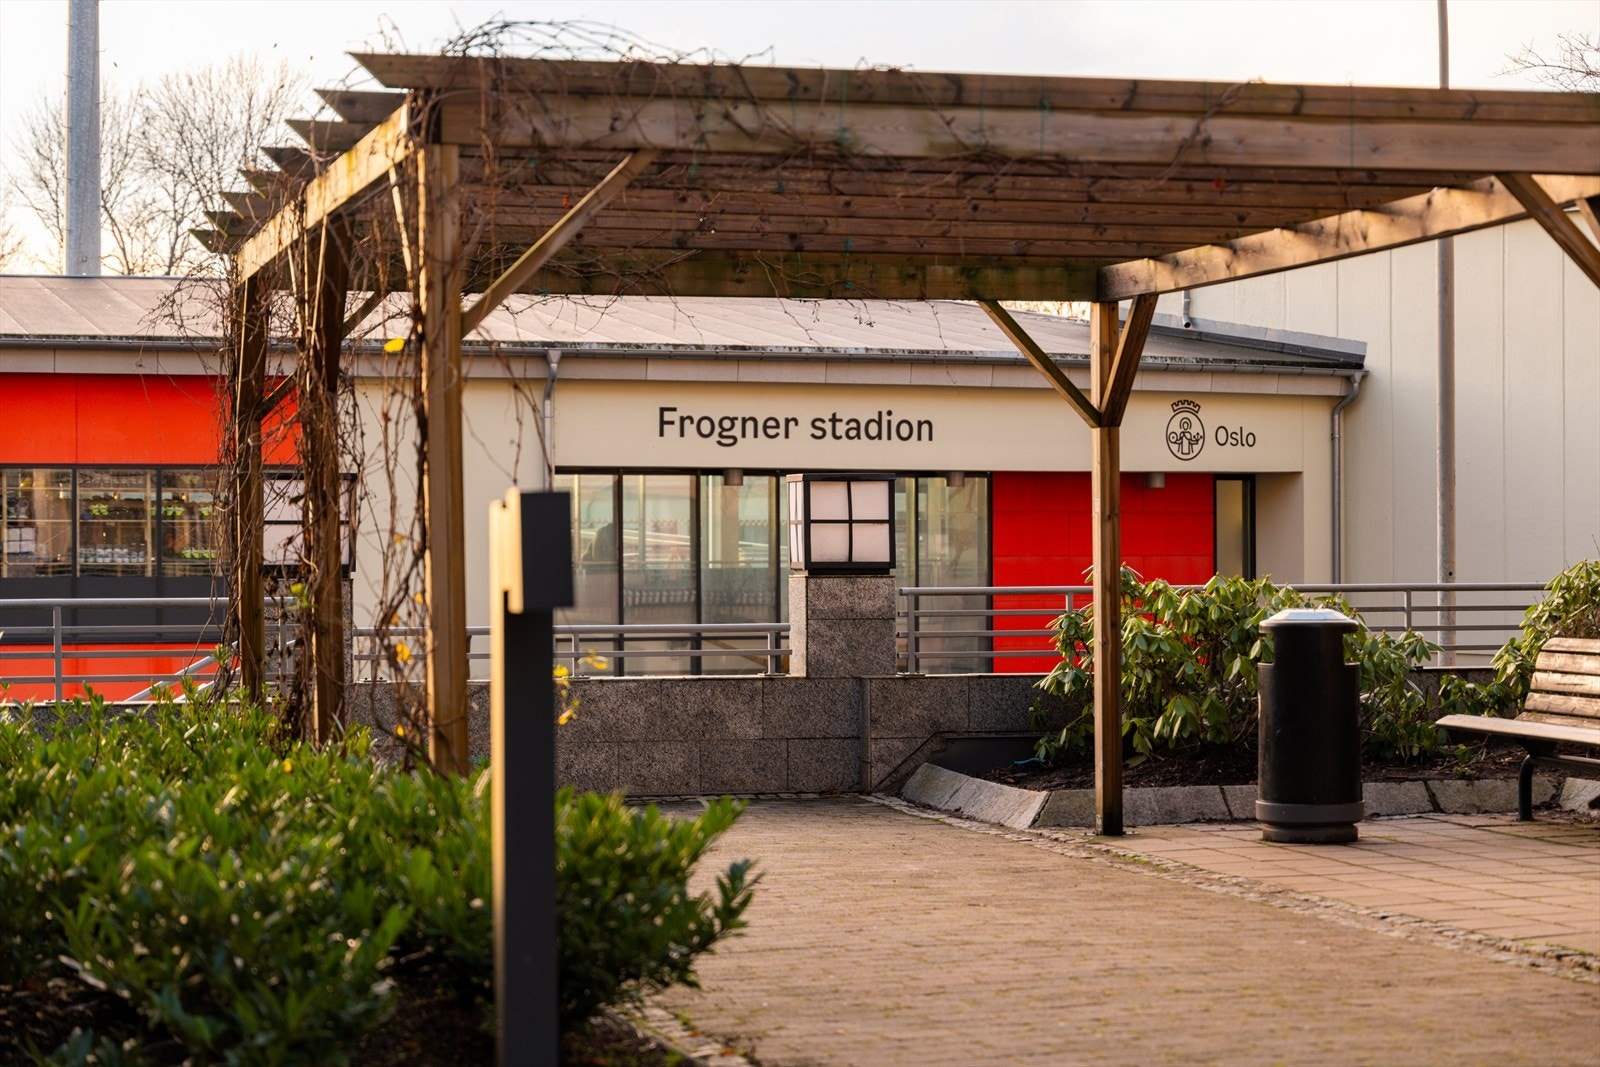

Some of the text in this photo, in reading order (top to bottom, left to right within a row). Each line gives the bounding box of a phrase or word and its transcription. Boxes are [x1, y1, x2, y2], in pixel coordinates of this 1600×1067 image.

[658, 406, 934, 447] Frogner stadion
[1214, 425, 1257, 448] Oslo
